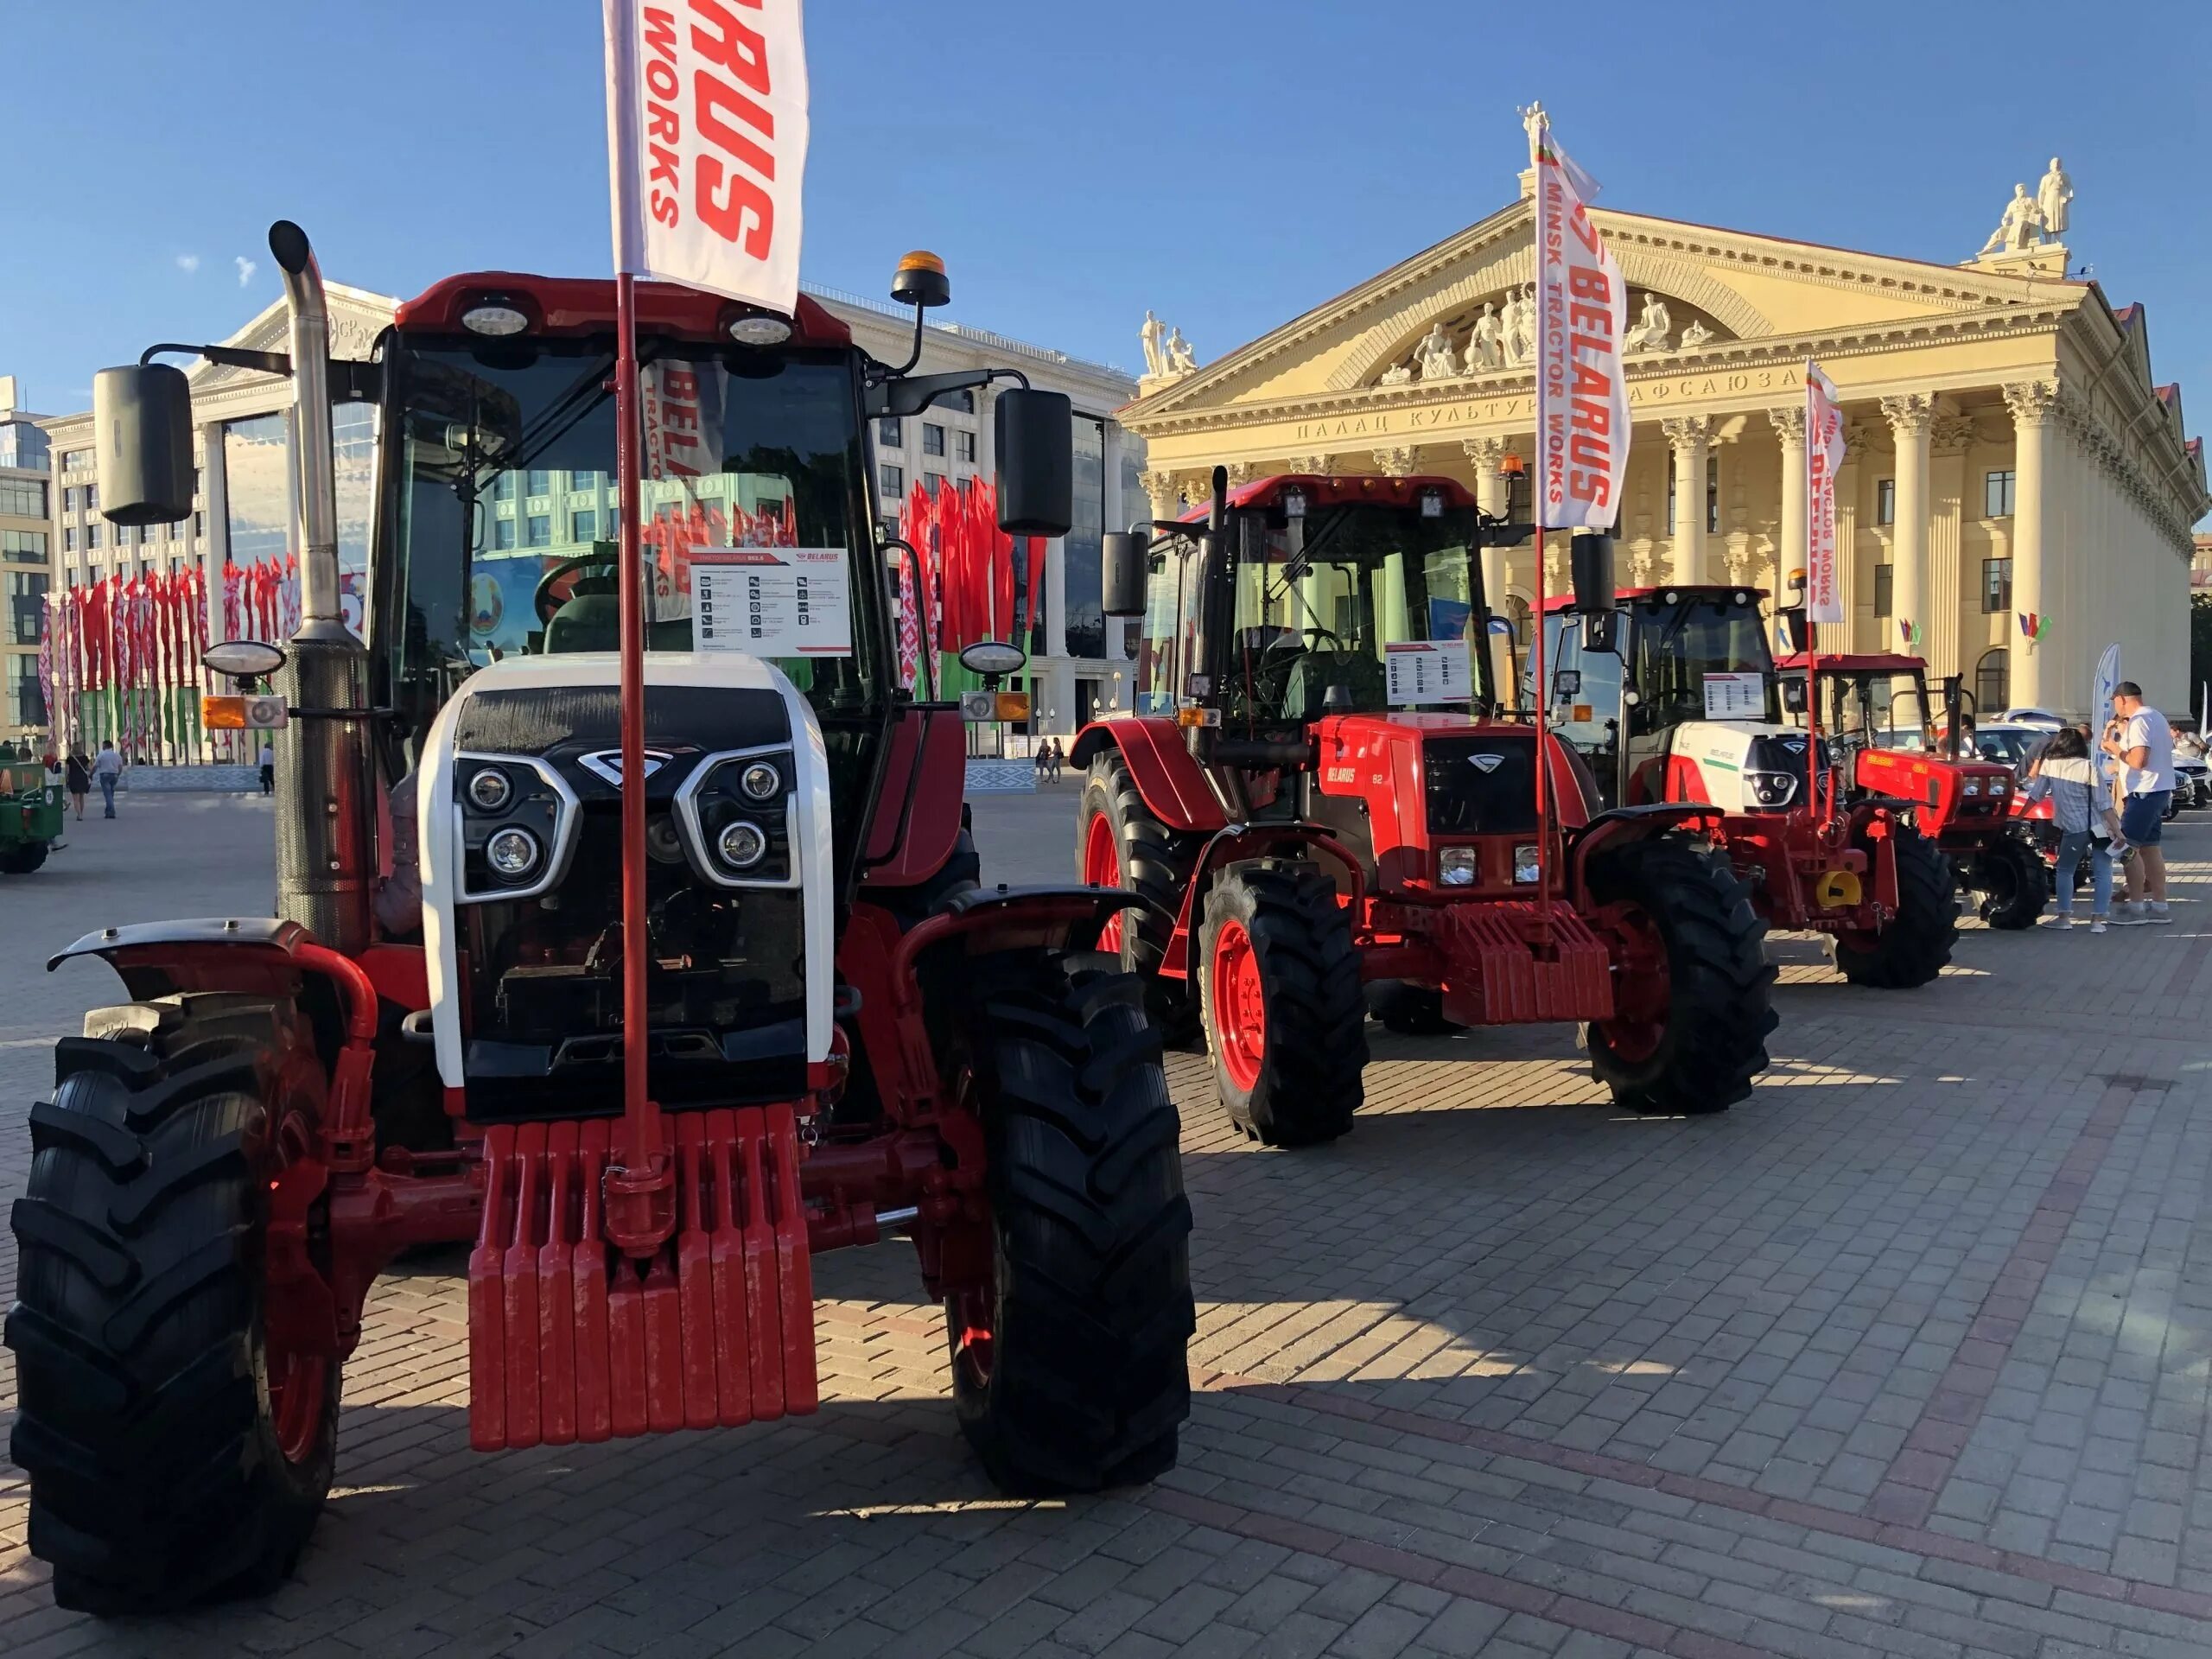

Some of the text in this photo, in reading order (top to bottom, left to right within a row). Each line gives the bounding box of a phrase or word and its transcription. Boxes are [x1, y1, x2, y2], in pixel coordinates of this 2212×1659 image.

[644, 7, 680, 229] WORKS
[689, 0, 775, 261] RUS
[646, 383, 662, 480] TRACTO
[1297, 369, 1799, 439] ПАЛАЦ КУЛЬТУР АФСАЮЗА
[1547, 182, 1564, 504] MINSK TRACTOR WORKS
[1569, 265, 1612, 508] BELARUS
[1327, 767, 1356, 784] BELARUS
